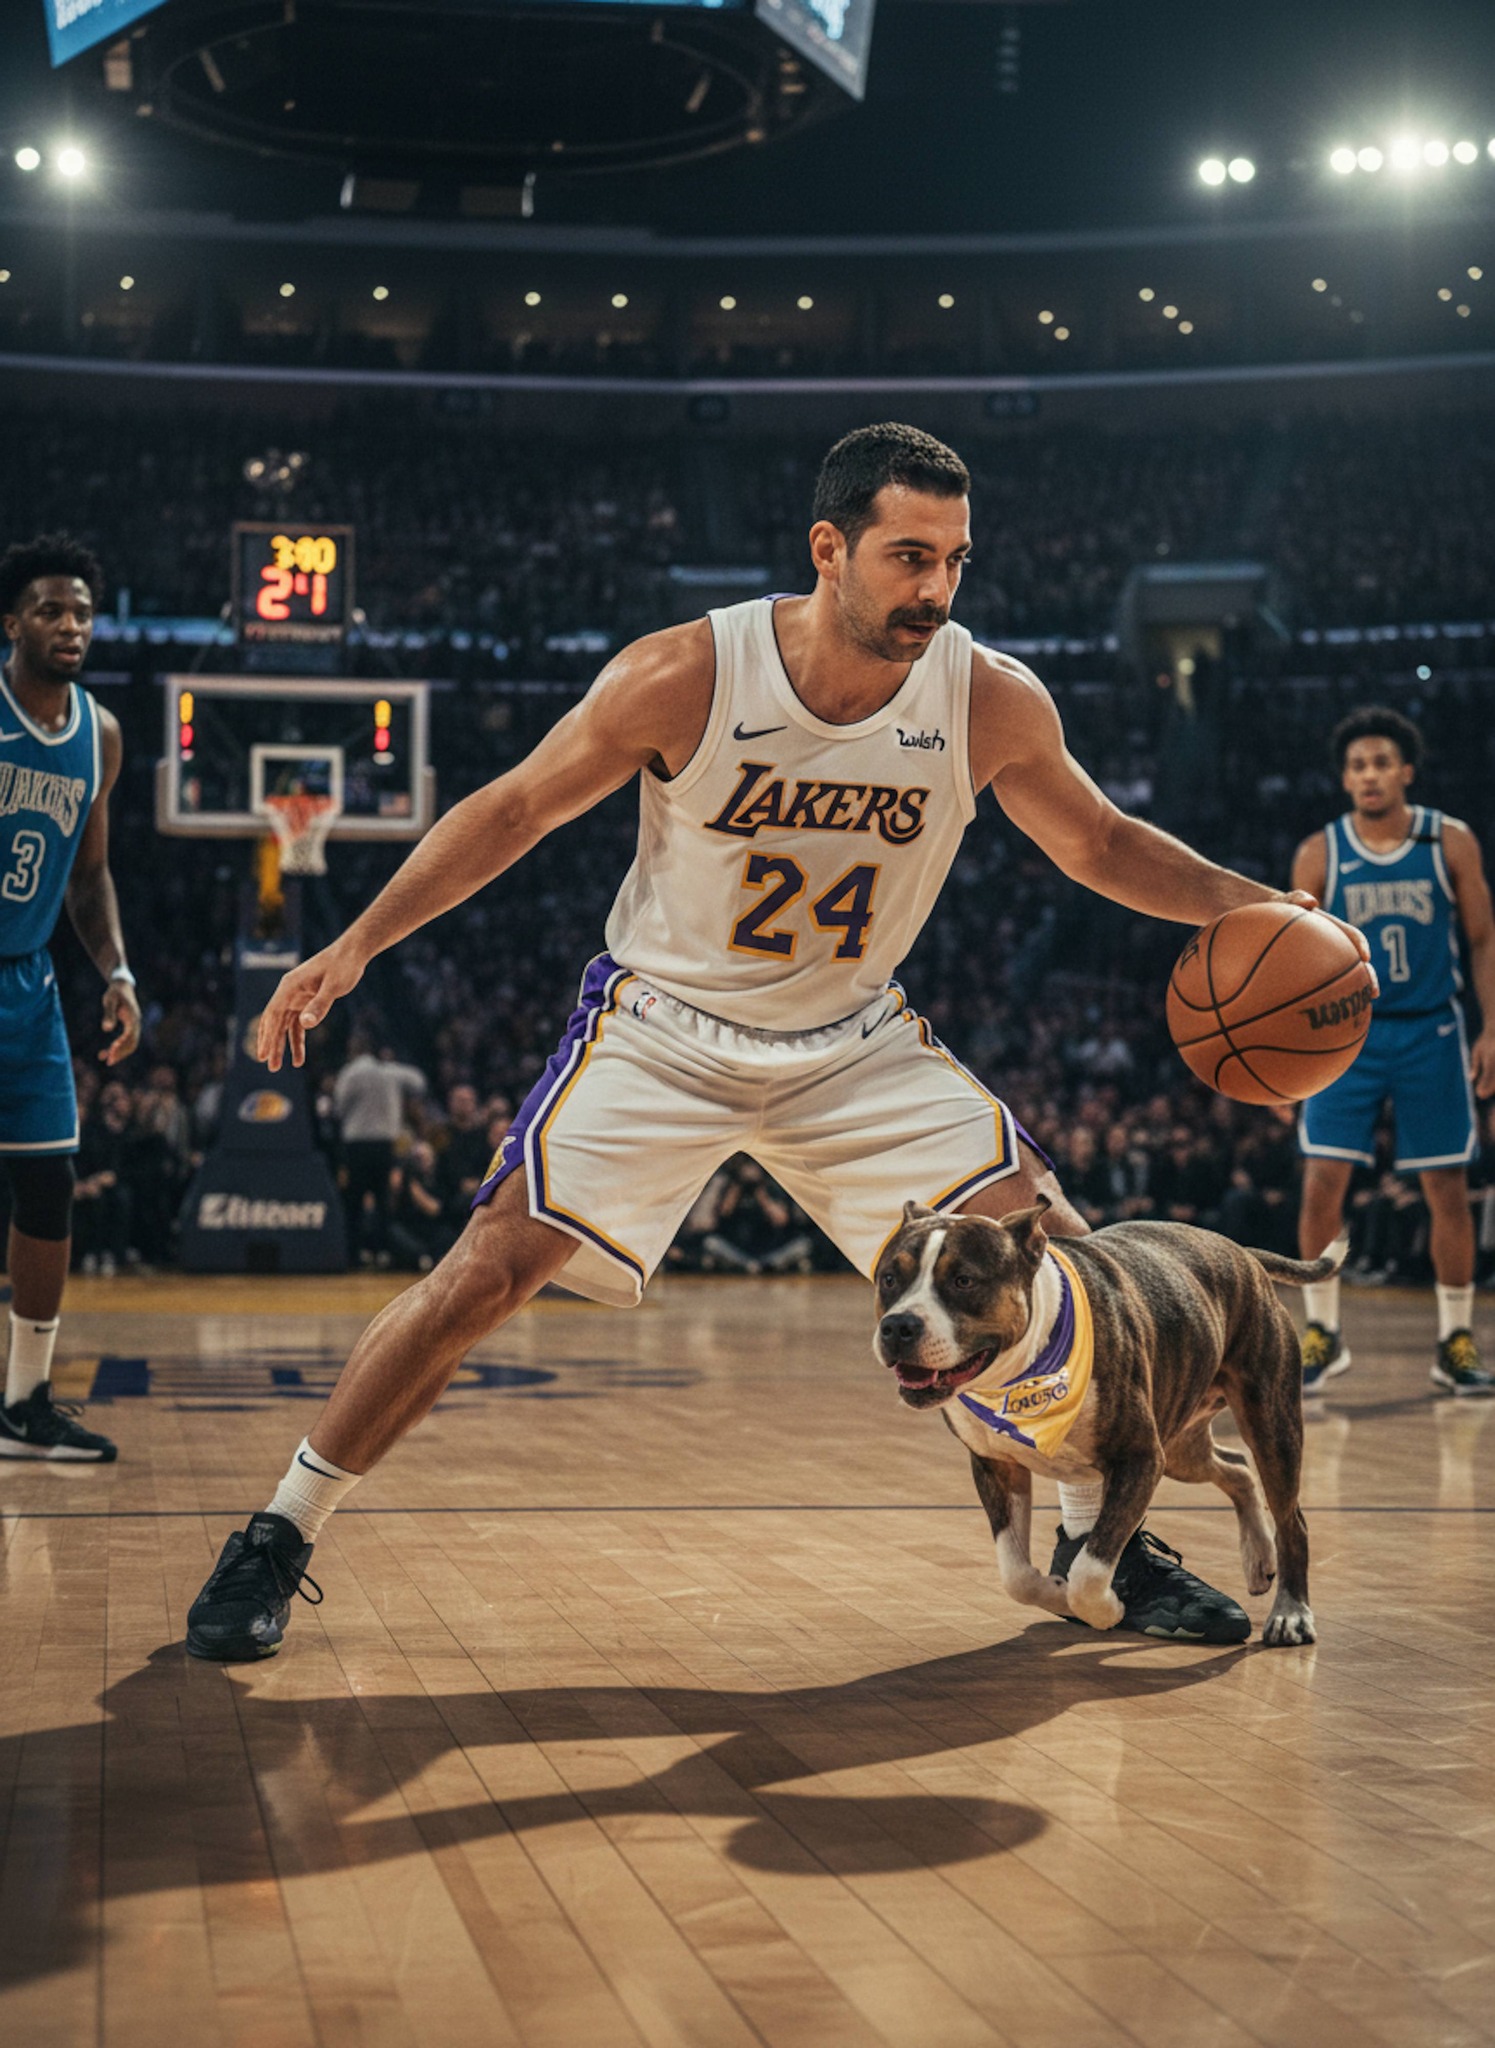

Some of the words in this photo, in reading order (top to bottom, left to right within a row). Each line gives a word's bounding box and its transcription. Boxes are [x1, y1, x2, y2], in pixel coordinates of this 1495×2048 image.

[256, 565, 328, 620] 24
[702, 759, 931, 848] LAKERS
[2, 829, 46, 902] 3
[727, 850, 882, 964] 24
[1381, 924, 1411, 983] 1
